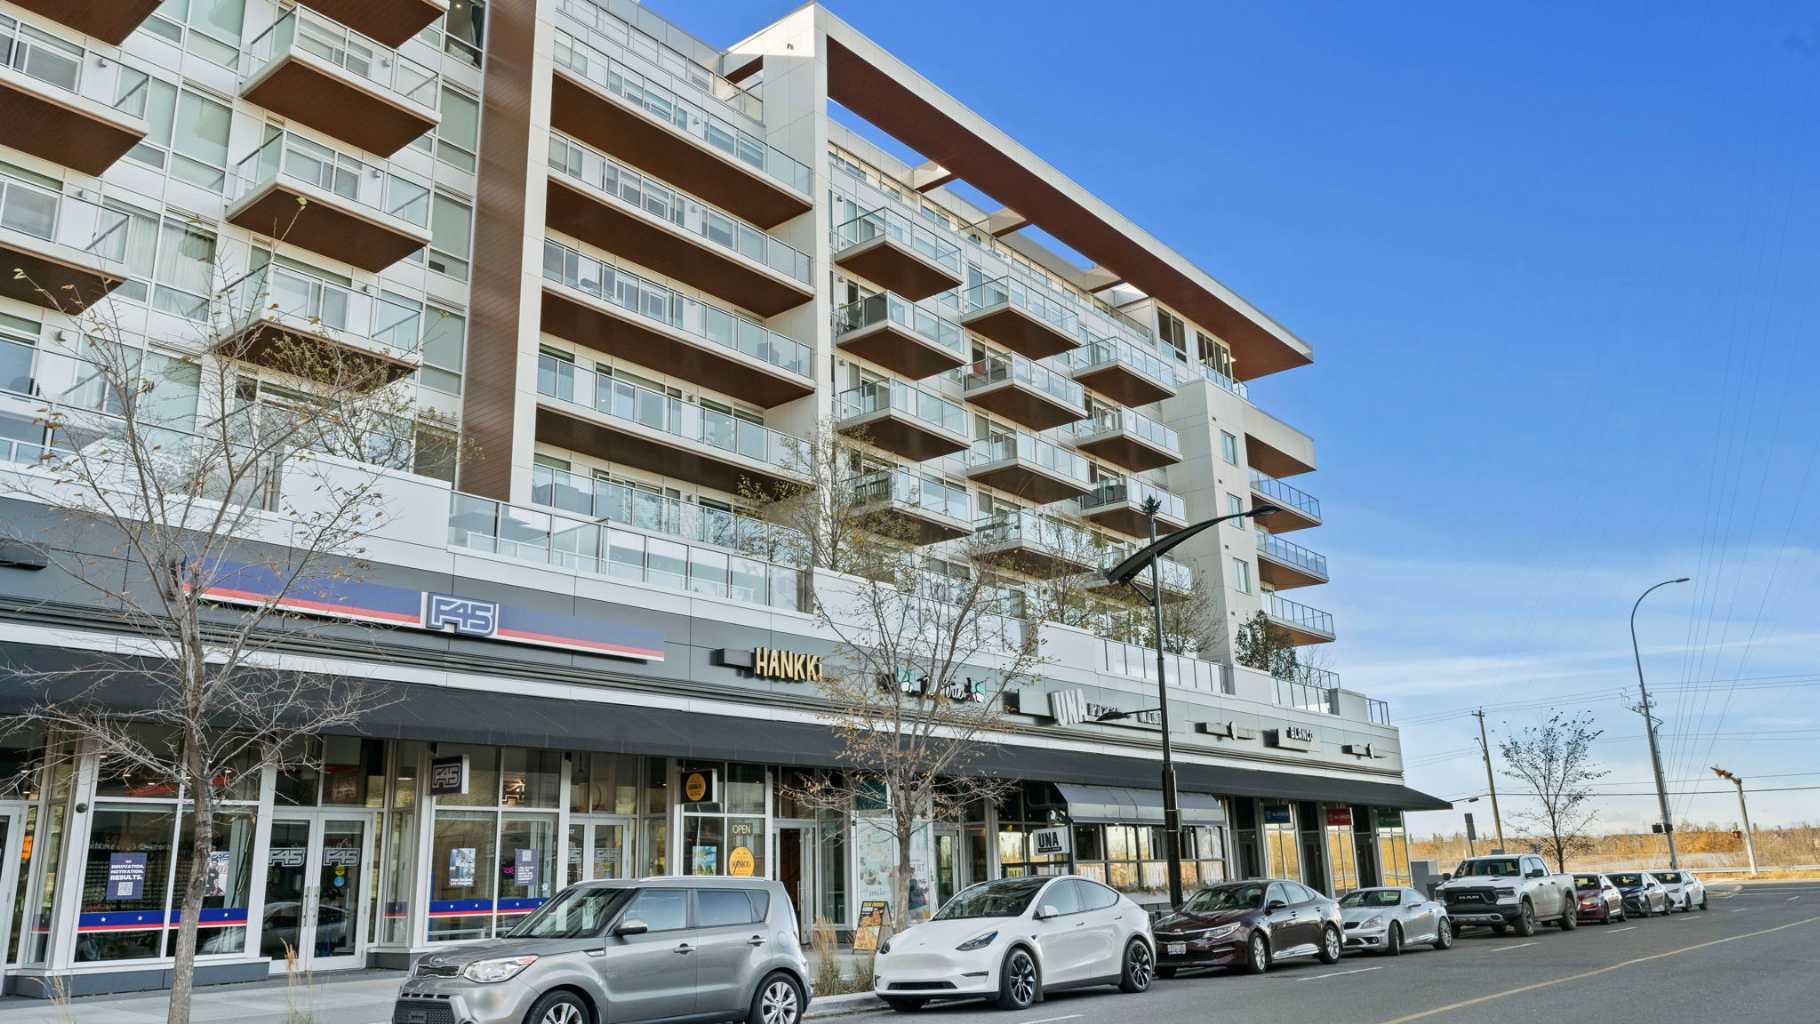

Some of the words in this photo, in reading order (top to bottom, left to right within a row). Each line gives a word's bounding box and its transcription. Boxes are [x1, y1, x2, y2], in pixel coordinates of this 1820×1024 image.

[431, 595, 494, 633] F45
[1053, 687, 1088, 726] UNA
[432, 763, 461, 788] F45
[732, 824, 751, 834] OPEN
[1038, 832, 1059, 847] UNA
[268, 848, 306, 866] F45
[323, 848, 360, 866] F45
